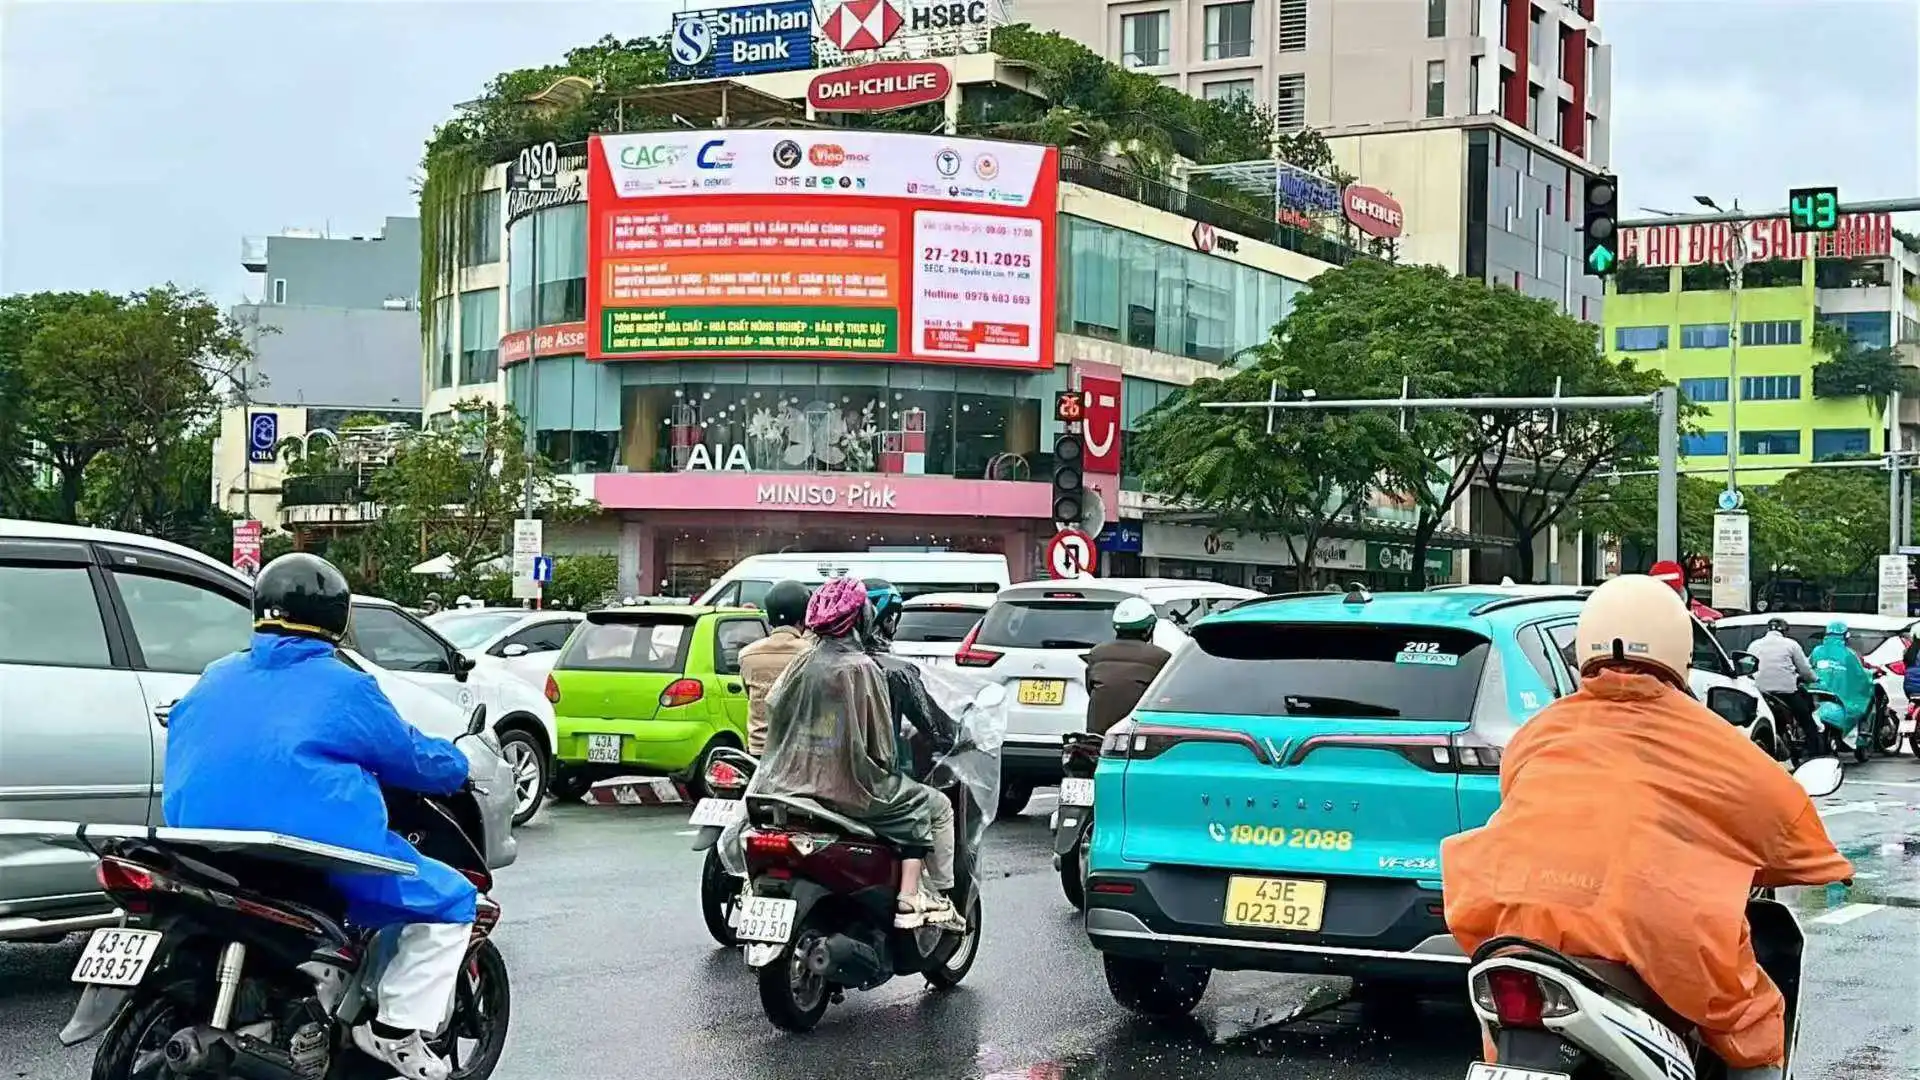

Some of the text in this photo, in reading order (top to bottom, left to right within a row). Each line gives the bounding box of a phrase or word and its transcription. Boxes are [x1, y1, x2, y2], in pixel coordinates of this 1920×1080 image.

[717, 8, 808, 36] Shinhan
[912, 1, 986, 29] HSBC
[733, 36, 789, 63] Bank
[620, 145, 666, 166] CAC
[508, 175, 581, 217] Restaurant
[1792, 193, 1836, 228] 43
[924, 247, 1031, 268] 27-29.11.2025
[1059, 395, 1080, 416] 26
[686, 443, 752, 473] AIA
[756, 480, 897, 509] MINISO Pink
[1403, 641, 1441, 653] 202
[1200, 792, 1361, 811] VINFAST
[1229, 824, 1354, 851] 1900 2088
[1255, 880, 1297, 902] 43E
[749, 899, 787, 920] 43-E1
[1235, 901, 1310, 926] 023.92
[739, 919, 788, 939] 397.50
[79, 956, 143, 981] 039.57
